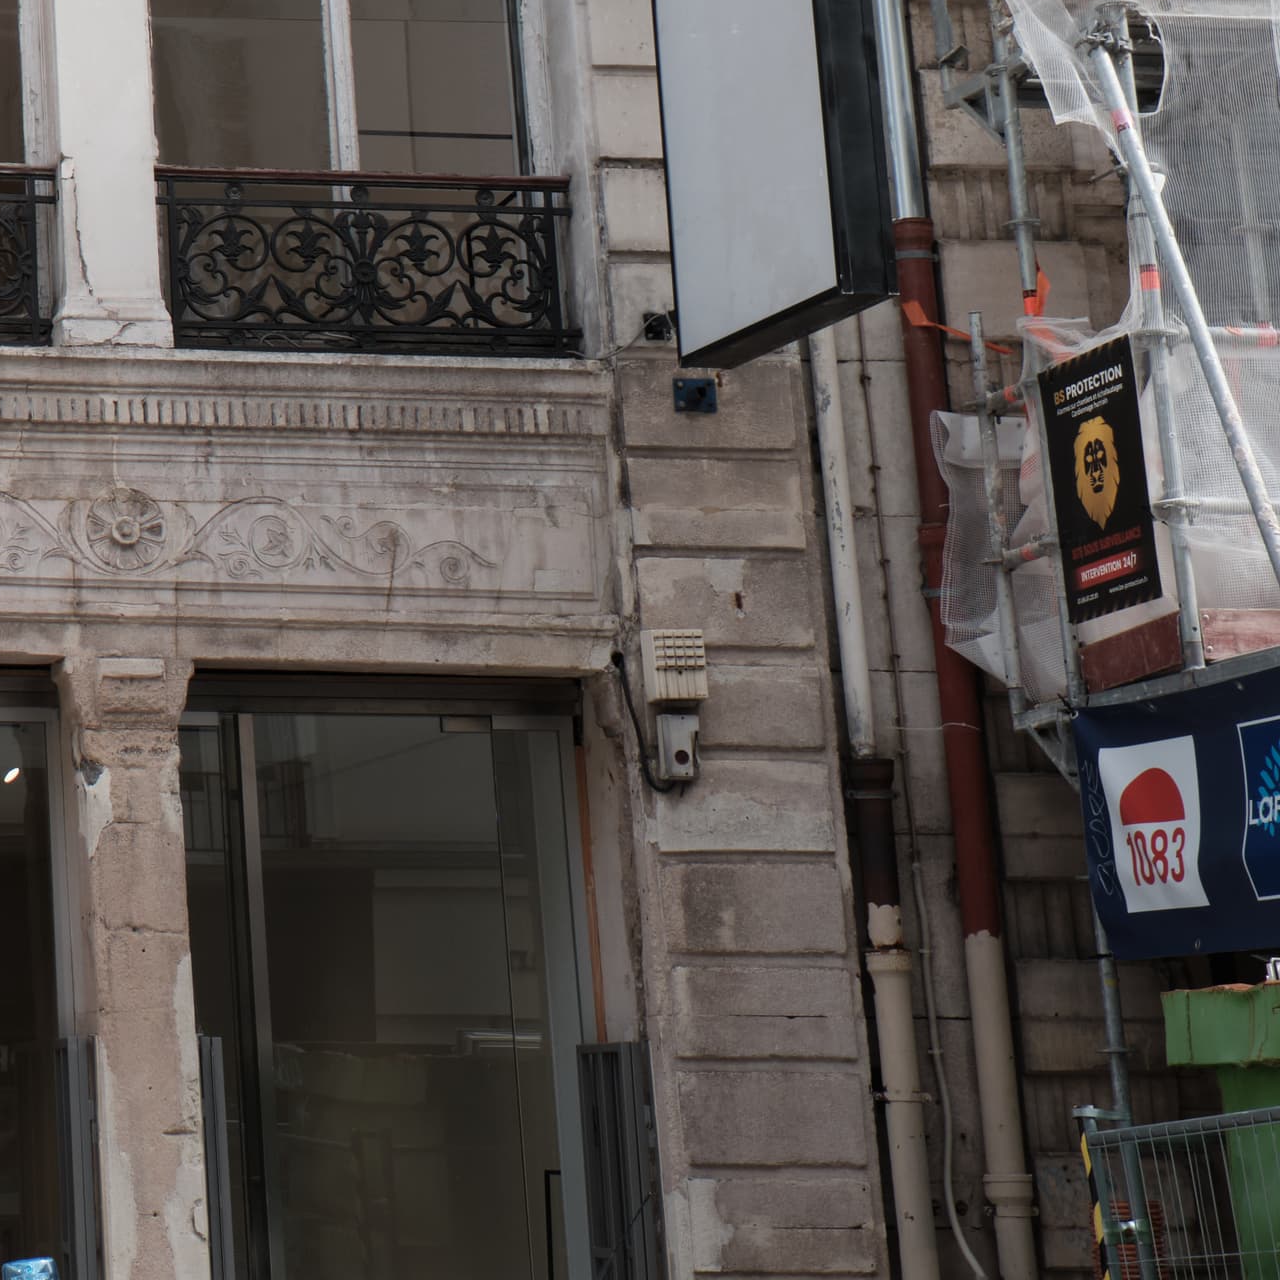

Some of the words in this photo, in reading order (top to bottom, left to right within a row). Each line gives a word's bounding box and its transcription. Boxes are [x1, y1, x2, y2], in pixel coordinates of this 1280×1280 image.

[1053, 389, 1065, 405] BS
[1065, 364, 1123, 400] PROTECTION
[1080, 559, 1122, 582] INTERVENTION
[1122, 551, 1137, 569] 24/7
[1126, 827, 1185, 886] 1083
